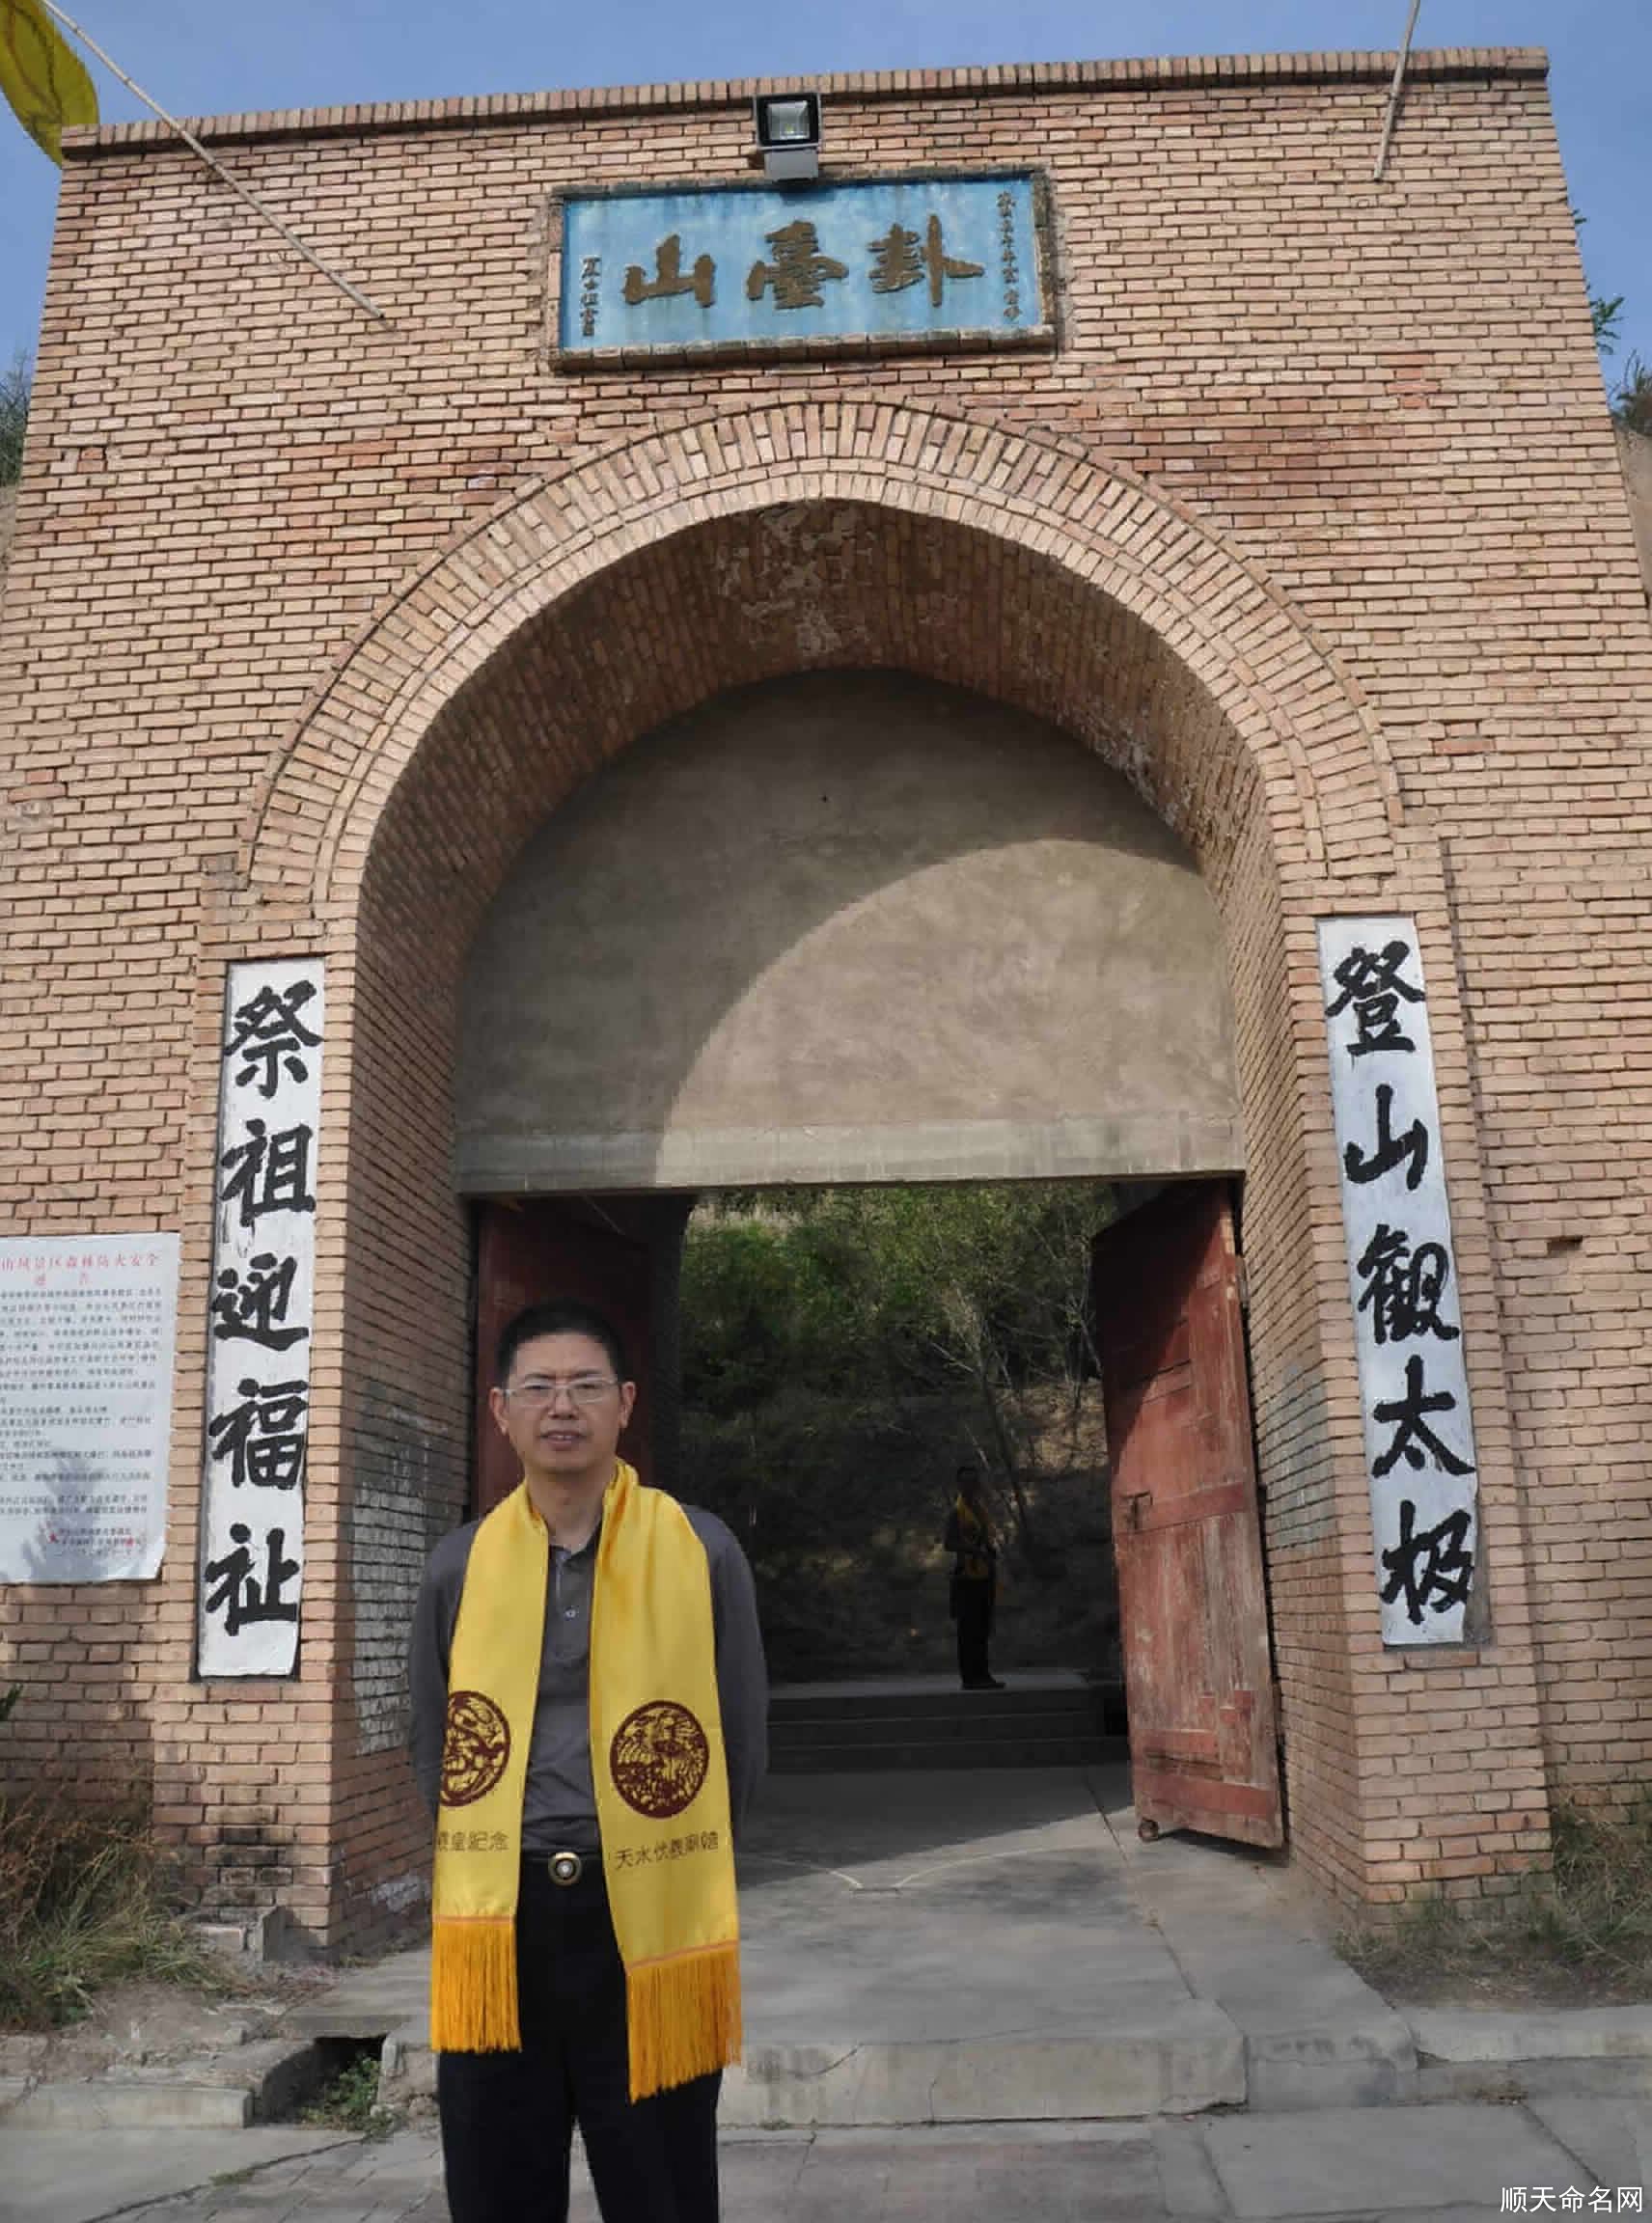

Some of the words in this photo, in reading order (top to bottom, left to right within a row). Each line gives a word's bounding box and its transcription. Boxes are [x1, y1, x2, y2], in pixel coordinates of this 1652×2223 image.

[204, 981, 320, 1633] 祭祖迎福祉
